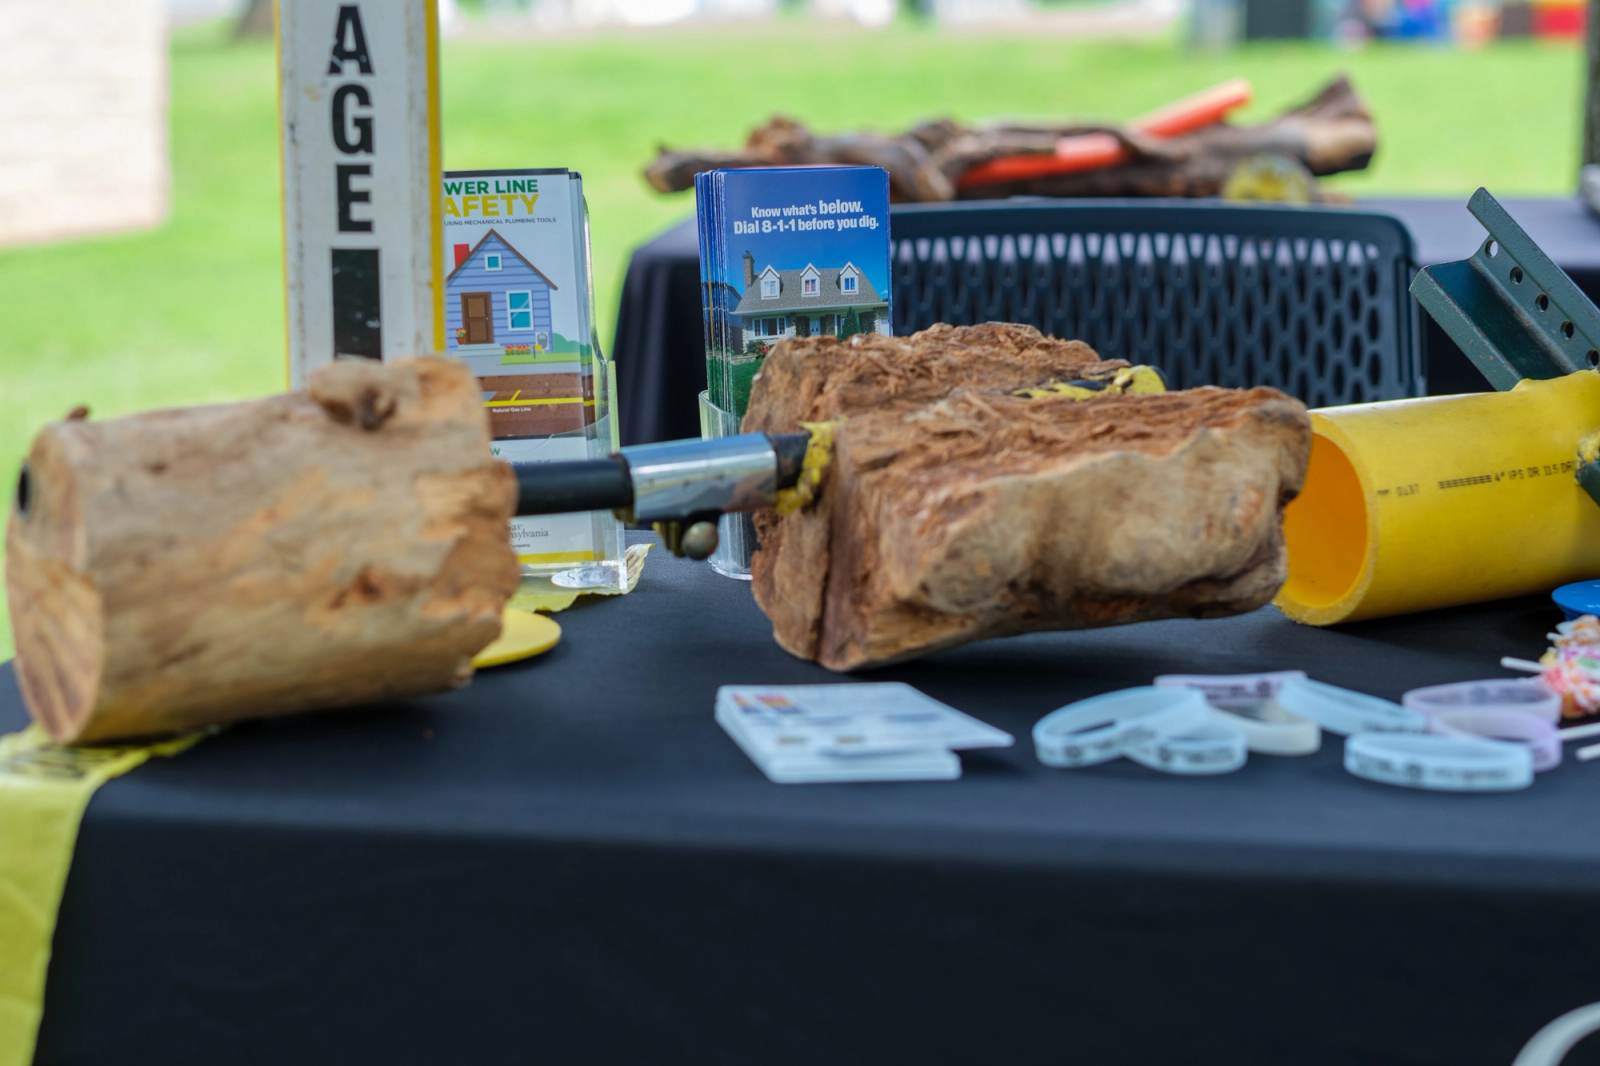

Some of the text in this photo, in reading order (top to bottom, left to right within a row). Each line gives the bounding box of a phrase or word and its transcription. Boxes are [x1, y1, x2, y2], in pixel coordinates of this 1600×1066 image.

[495, 179, 538, 193] LINE
[751, 199, 863, 218] Know what's below.
[464, 218, 503, 226] MECHANICAL
[504, 217, 535, 225] PLUMBING
[536, 216, 556, 224] TOOLS
[734, 215, 879, 234] Dial 8-1-1 before you dig.
